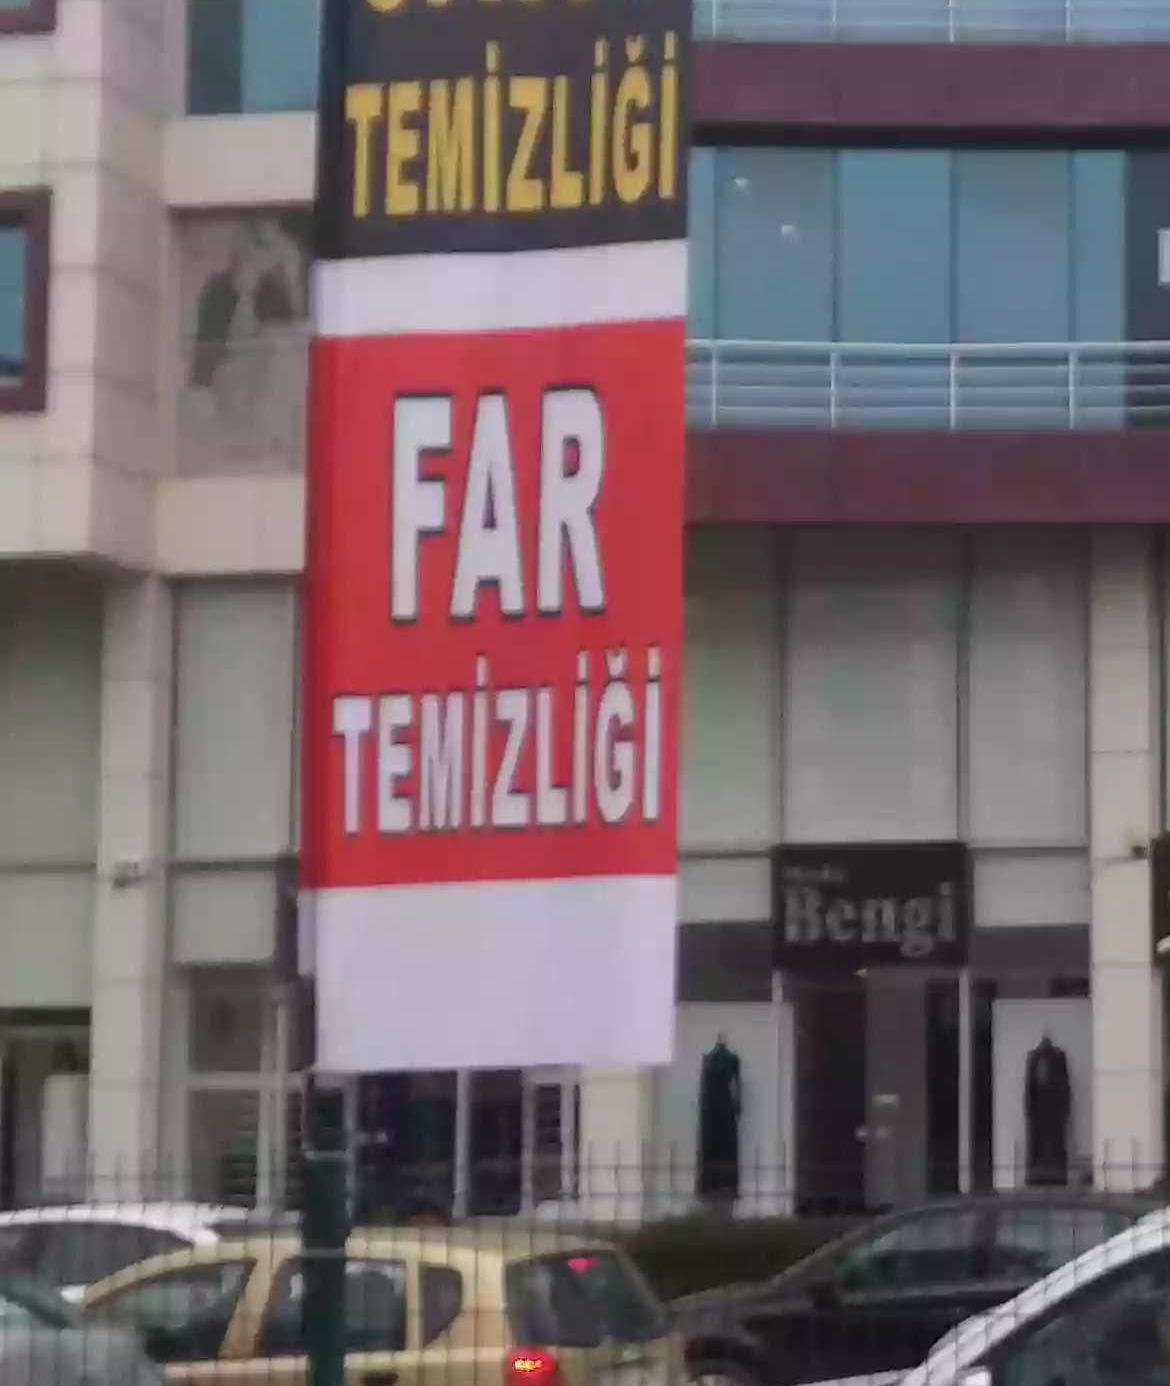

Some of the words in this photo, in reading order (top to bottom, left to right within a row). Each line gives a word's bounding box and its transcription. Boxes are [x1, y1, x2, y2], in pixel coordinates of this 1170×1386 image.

[345, 30, 678, 218] TEMİZLİĞİ
[390, 384, 606, 624] FAR
[332, 644, 662, 835] TEMİZLİĞİ
